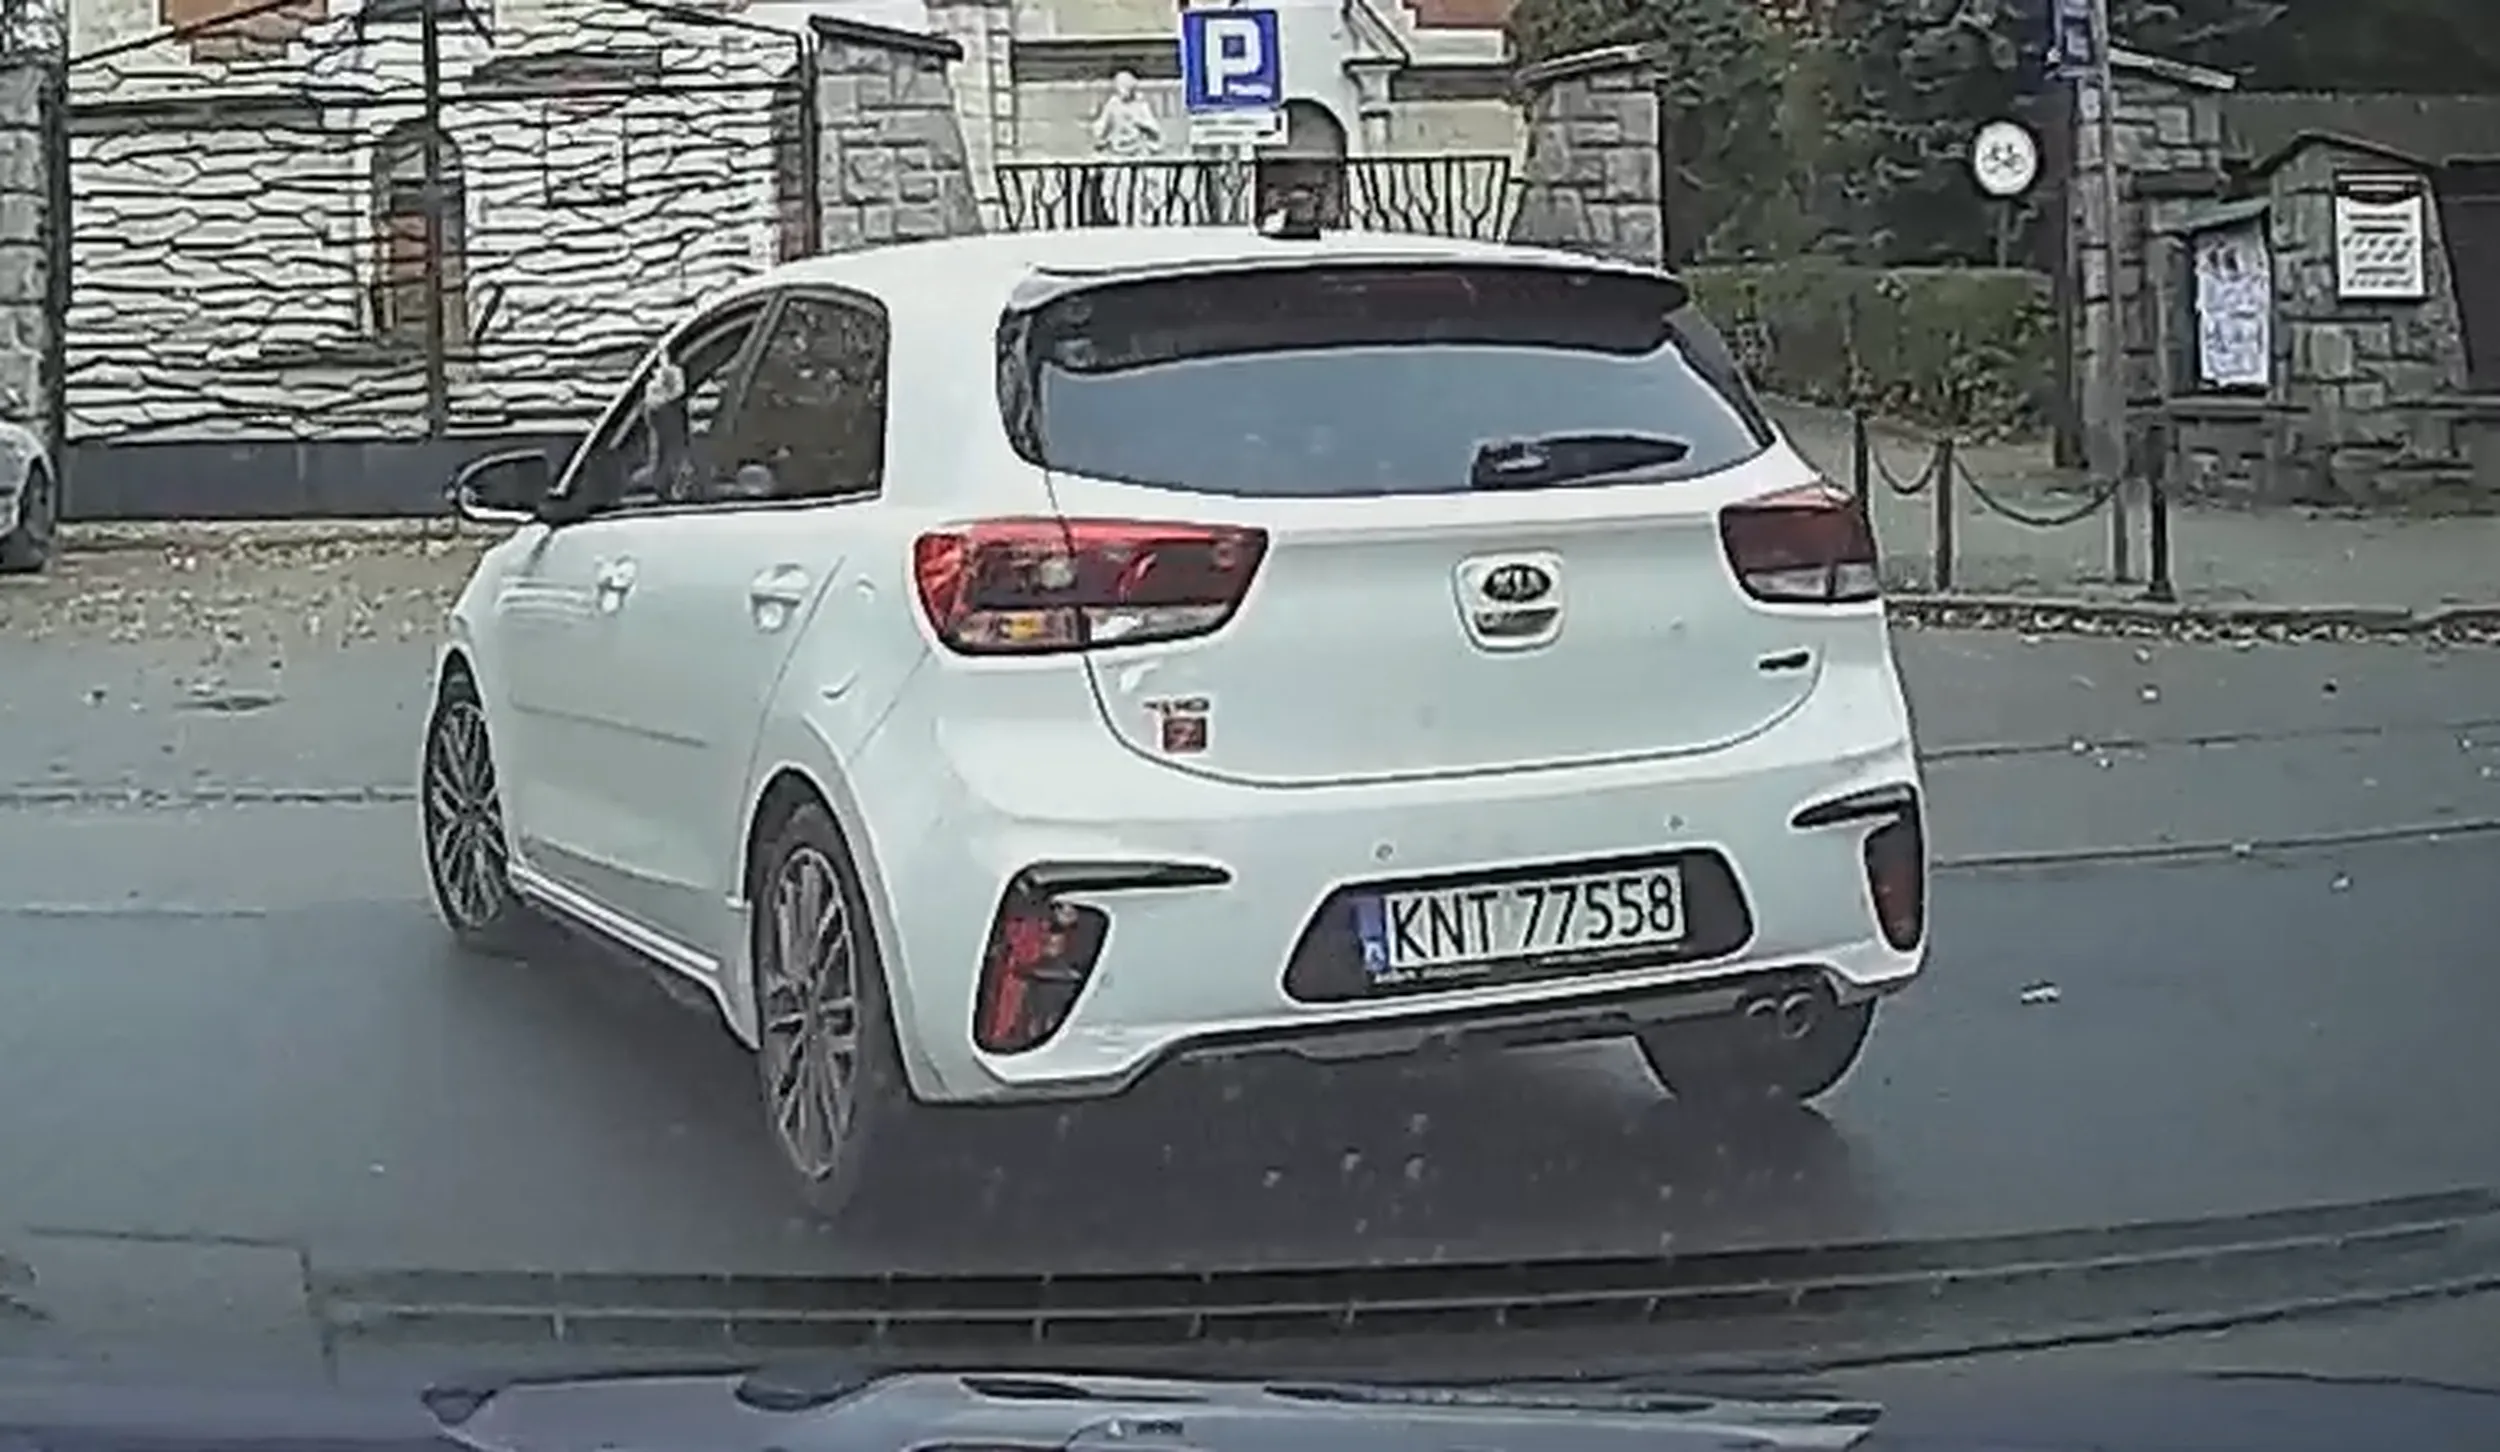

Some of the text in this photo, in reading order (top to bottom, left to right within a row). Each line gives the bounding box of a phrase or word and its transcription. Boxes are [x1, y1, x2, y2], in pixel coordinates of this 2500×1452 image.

[1205, 18, 1261, 96] P
[1392, 890, 1498, 962] KNT
[1515, 874, 1676, 948] 77558
